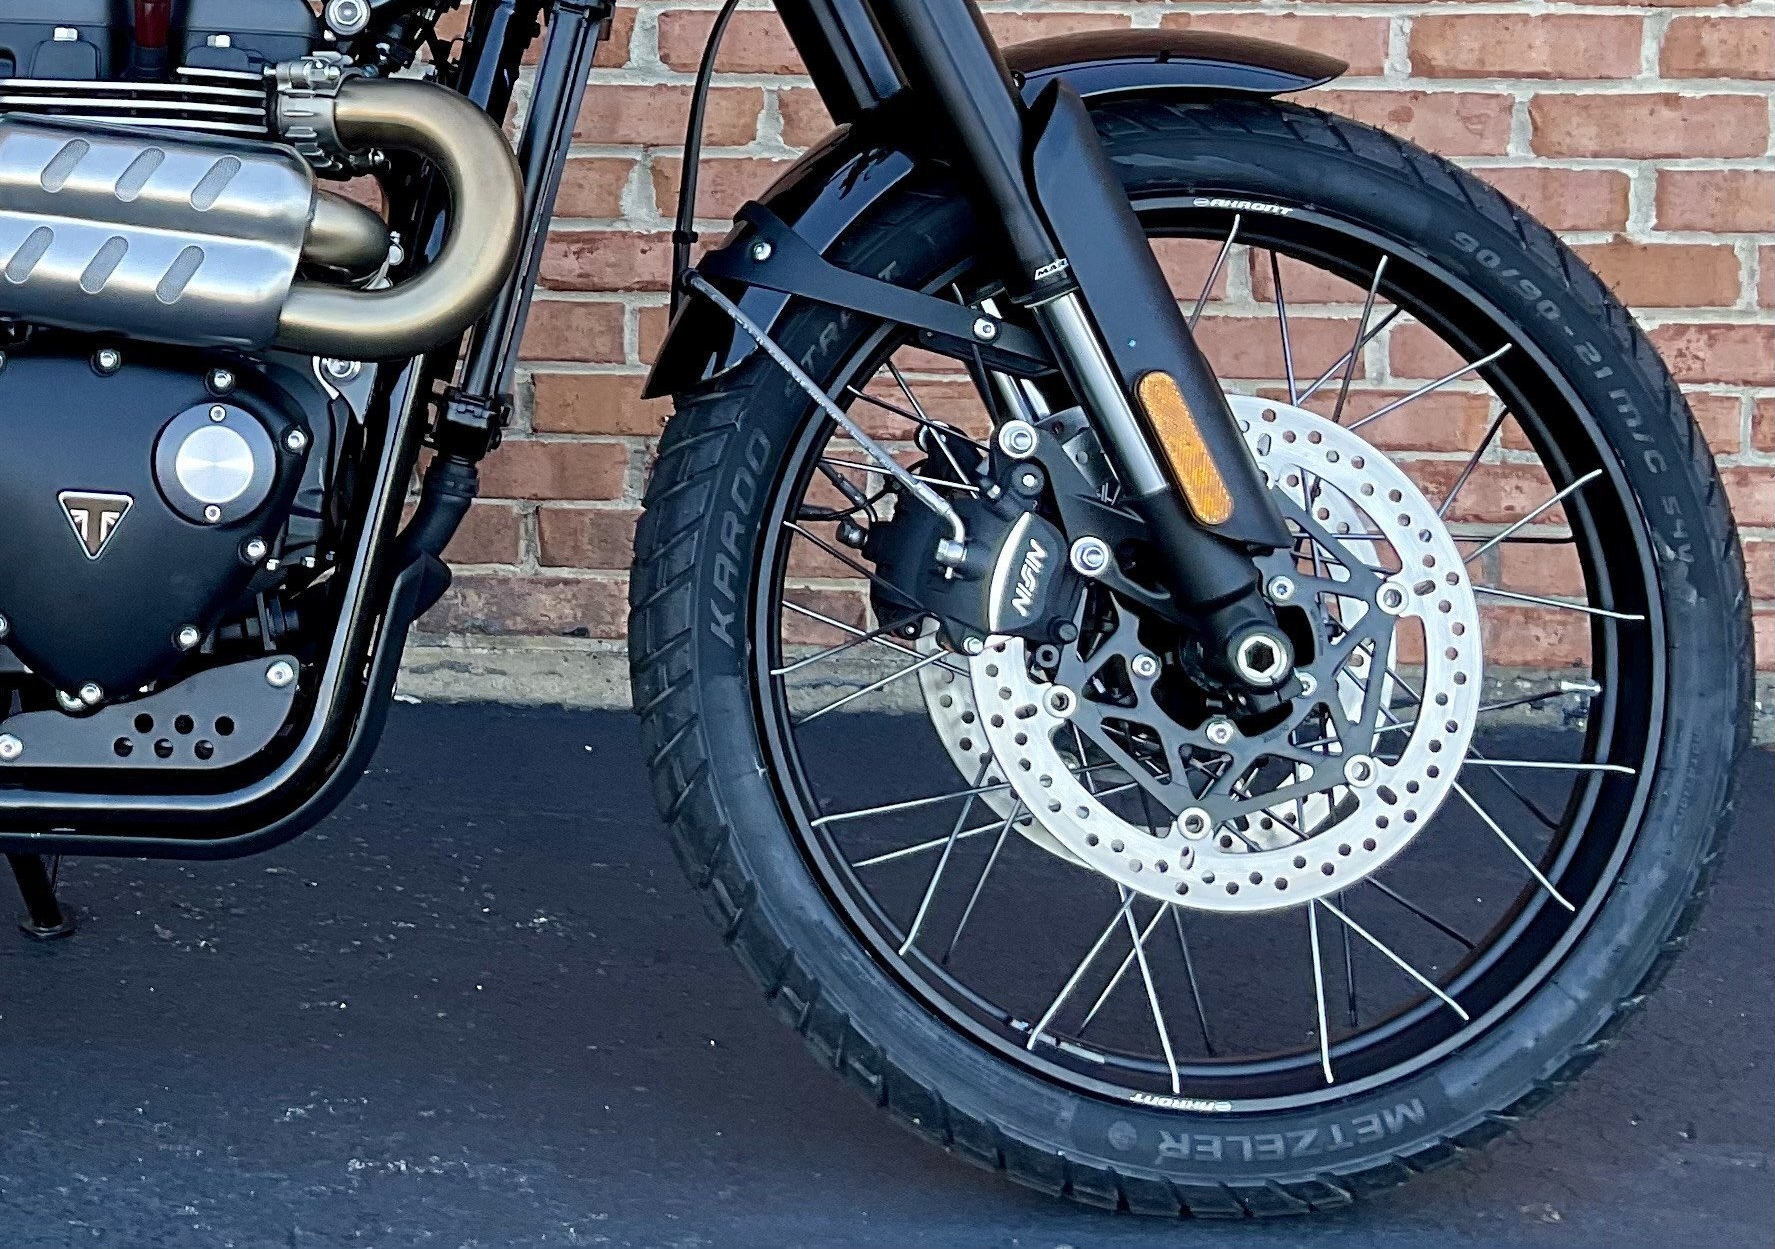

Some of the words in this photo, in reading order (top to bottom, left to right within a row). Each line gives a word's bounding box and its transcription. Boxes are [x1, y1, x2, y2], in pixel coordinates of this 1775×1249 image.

[709, 427, 771, 649] KAROO
[1011, 538, 1047, 617] NISSIN
[1154, 1098, 1425, 1165] METZELER
